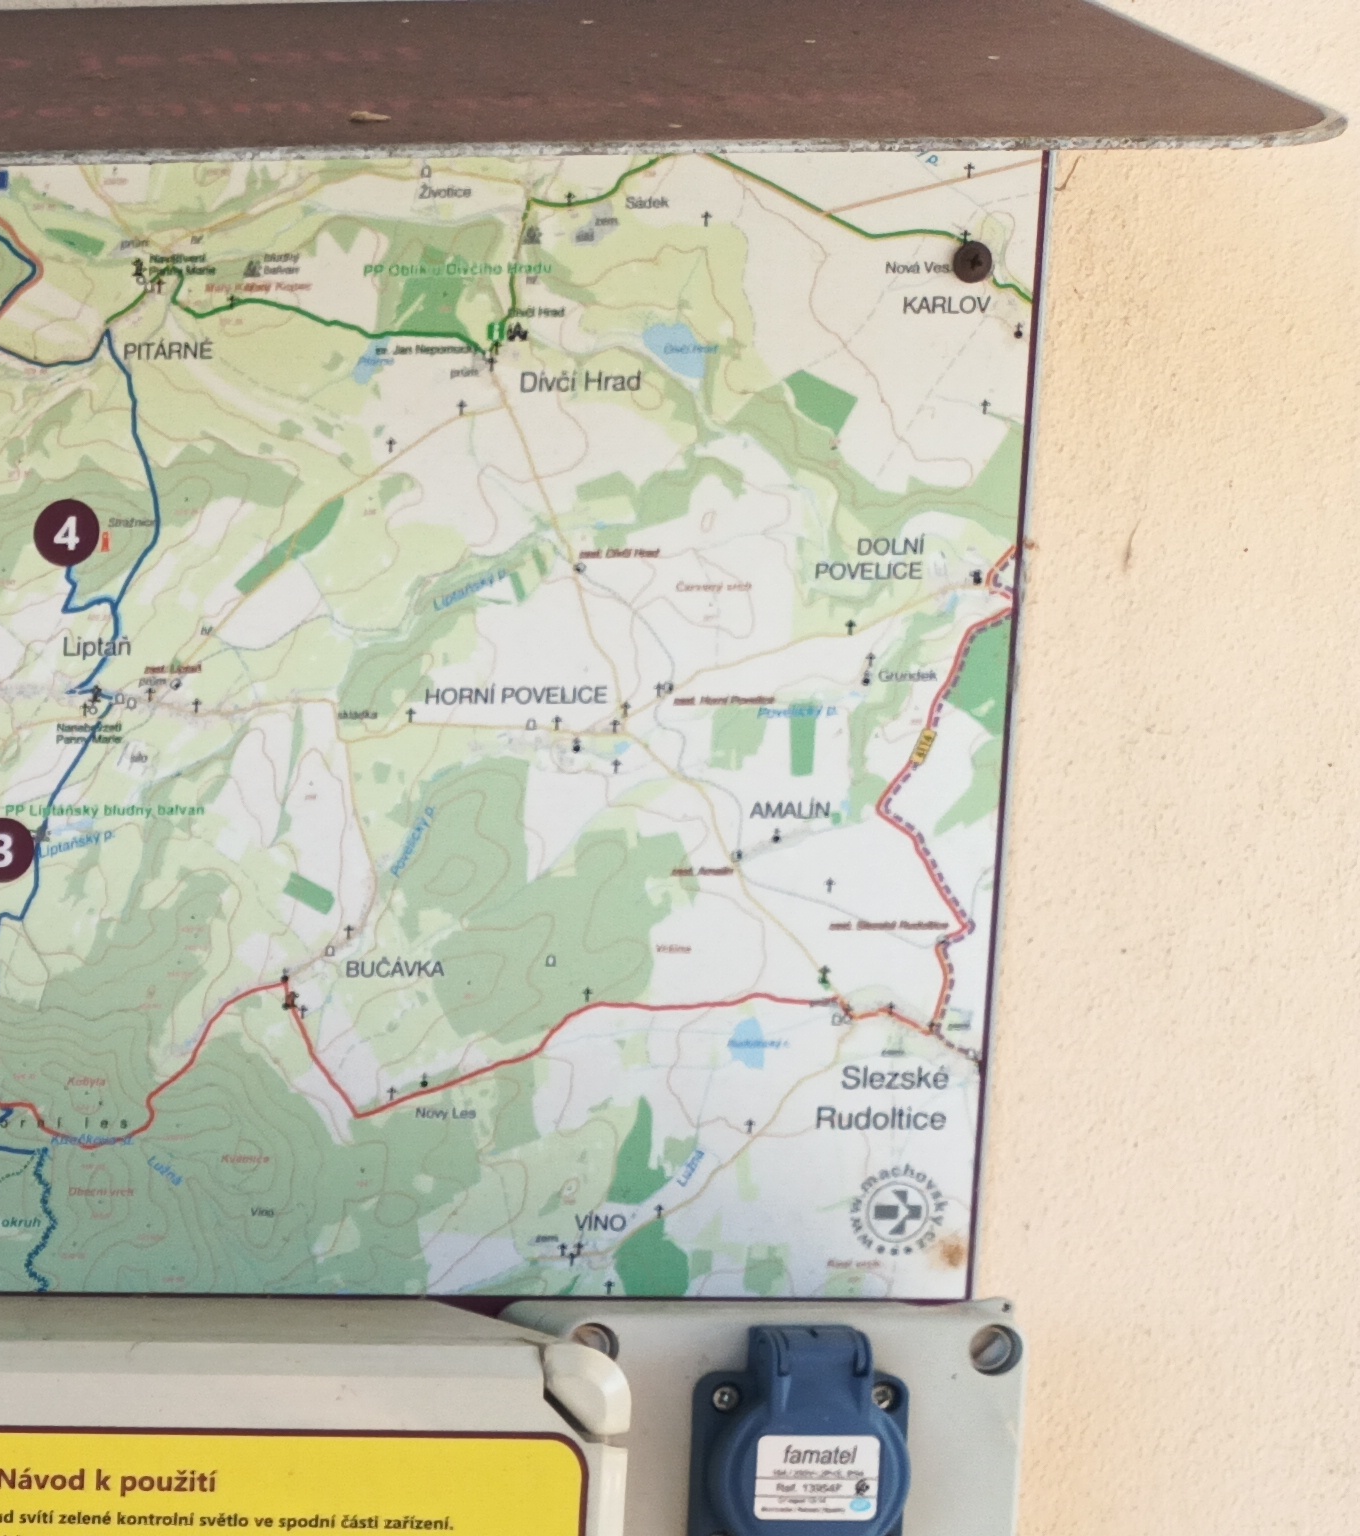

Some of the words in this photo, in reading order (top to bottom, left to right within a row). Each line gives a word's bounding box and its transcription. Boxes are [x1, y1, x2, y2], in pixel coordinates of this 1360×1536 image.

[886, 260, 920, 275] Nová
[924, 261, 949, 275] Ves
[903, 295, 991, 316] KARLOV
[123, 334, 213, 360] PITÁRNÉ
[520, 370, 576, 394] Dívčí
[582, 370, 641, 394] Hrad
[53, 515, 80, 551] 4
[857, 534, 924, 557] DOLNÍ
[814, 560, 923, 582] POVELICE
[63, 633, 131, 660] Liptaň
[424, 684, 495, 706] HORNÍ
[501, 686, 608, 708] POVELICE
[749, 797, 831, 820] AMALÍN
[346, 956, 445, 979] BUČÁVKA
[841, 1064, 950, 1092] Slezské
[815, 1105, 947, 1132] Rudoltice
[574, 1211, 627, 1232] VÍNO
[783, 1444, 859, 1465] famatel
[95, 1468, 111, 1492] k
[120, 1468, 216, 1498] použití
[19, 1509, 54, 1525] svítí
[58, 1510, 112, 1525] zelené
[116, 1511, 195, 1527] kontrolní
[199, 1512, 249, 1529] světlo
[254, 1516, 274, 1529] ve
[278, 1514, 336, 1532] spodní
[340, 1514, 379, 1530] části
[383, 1515, 454, 1532] zařízení.
